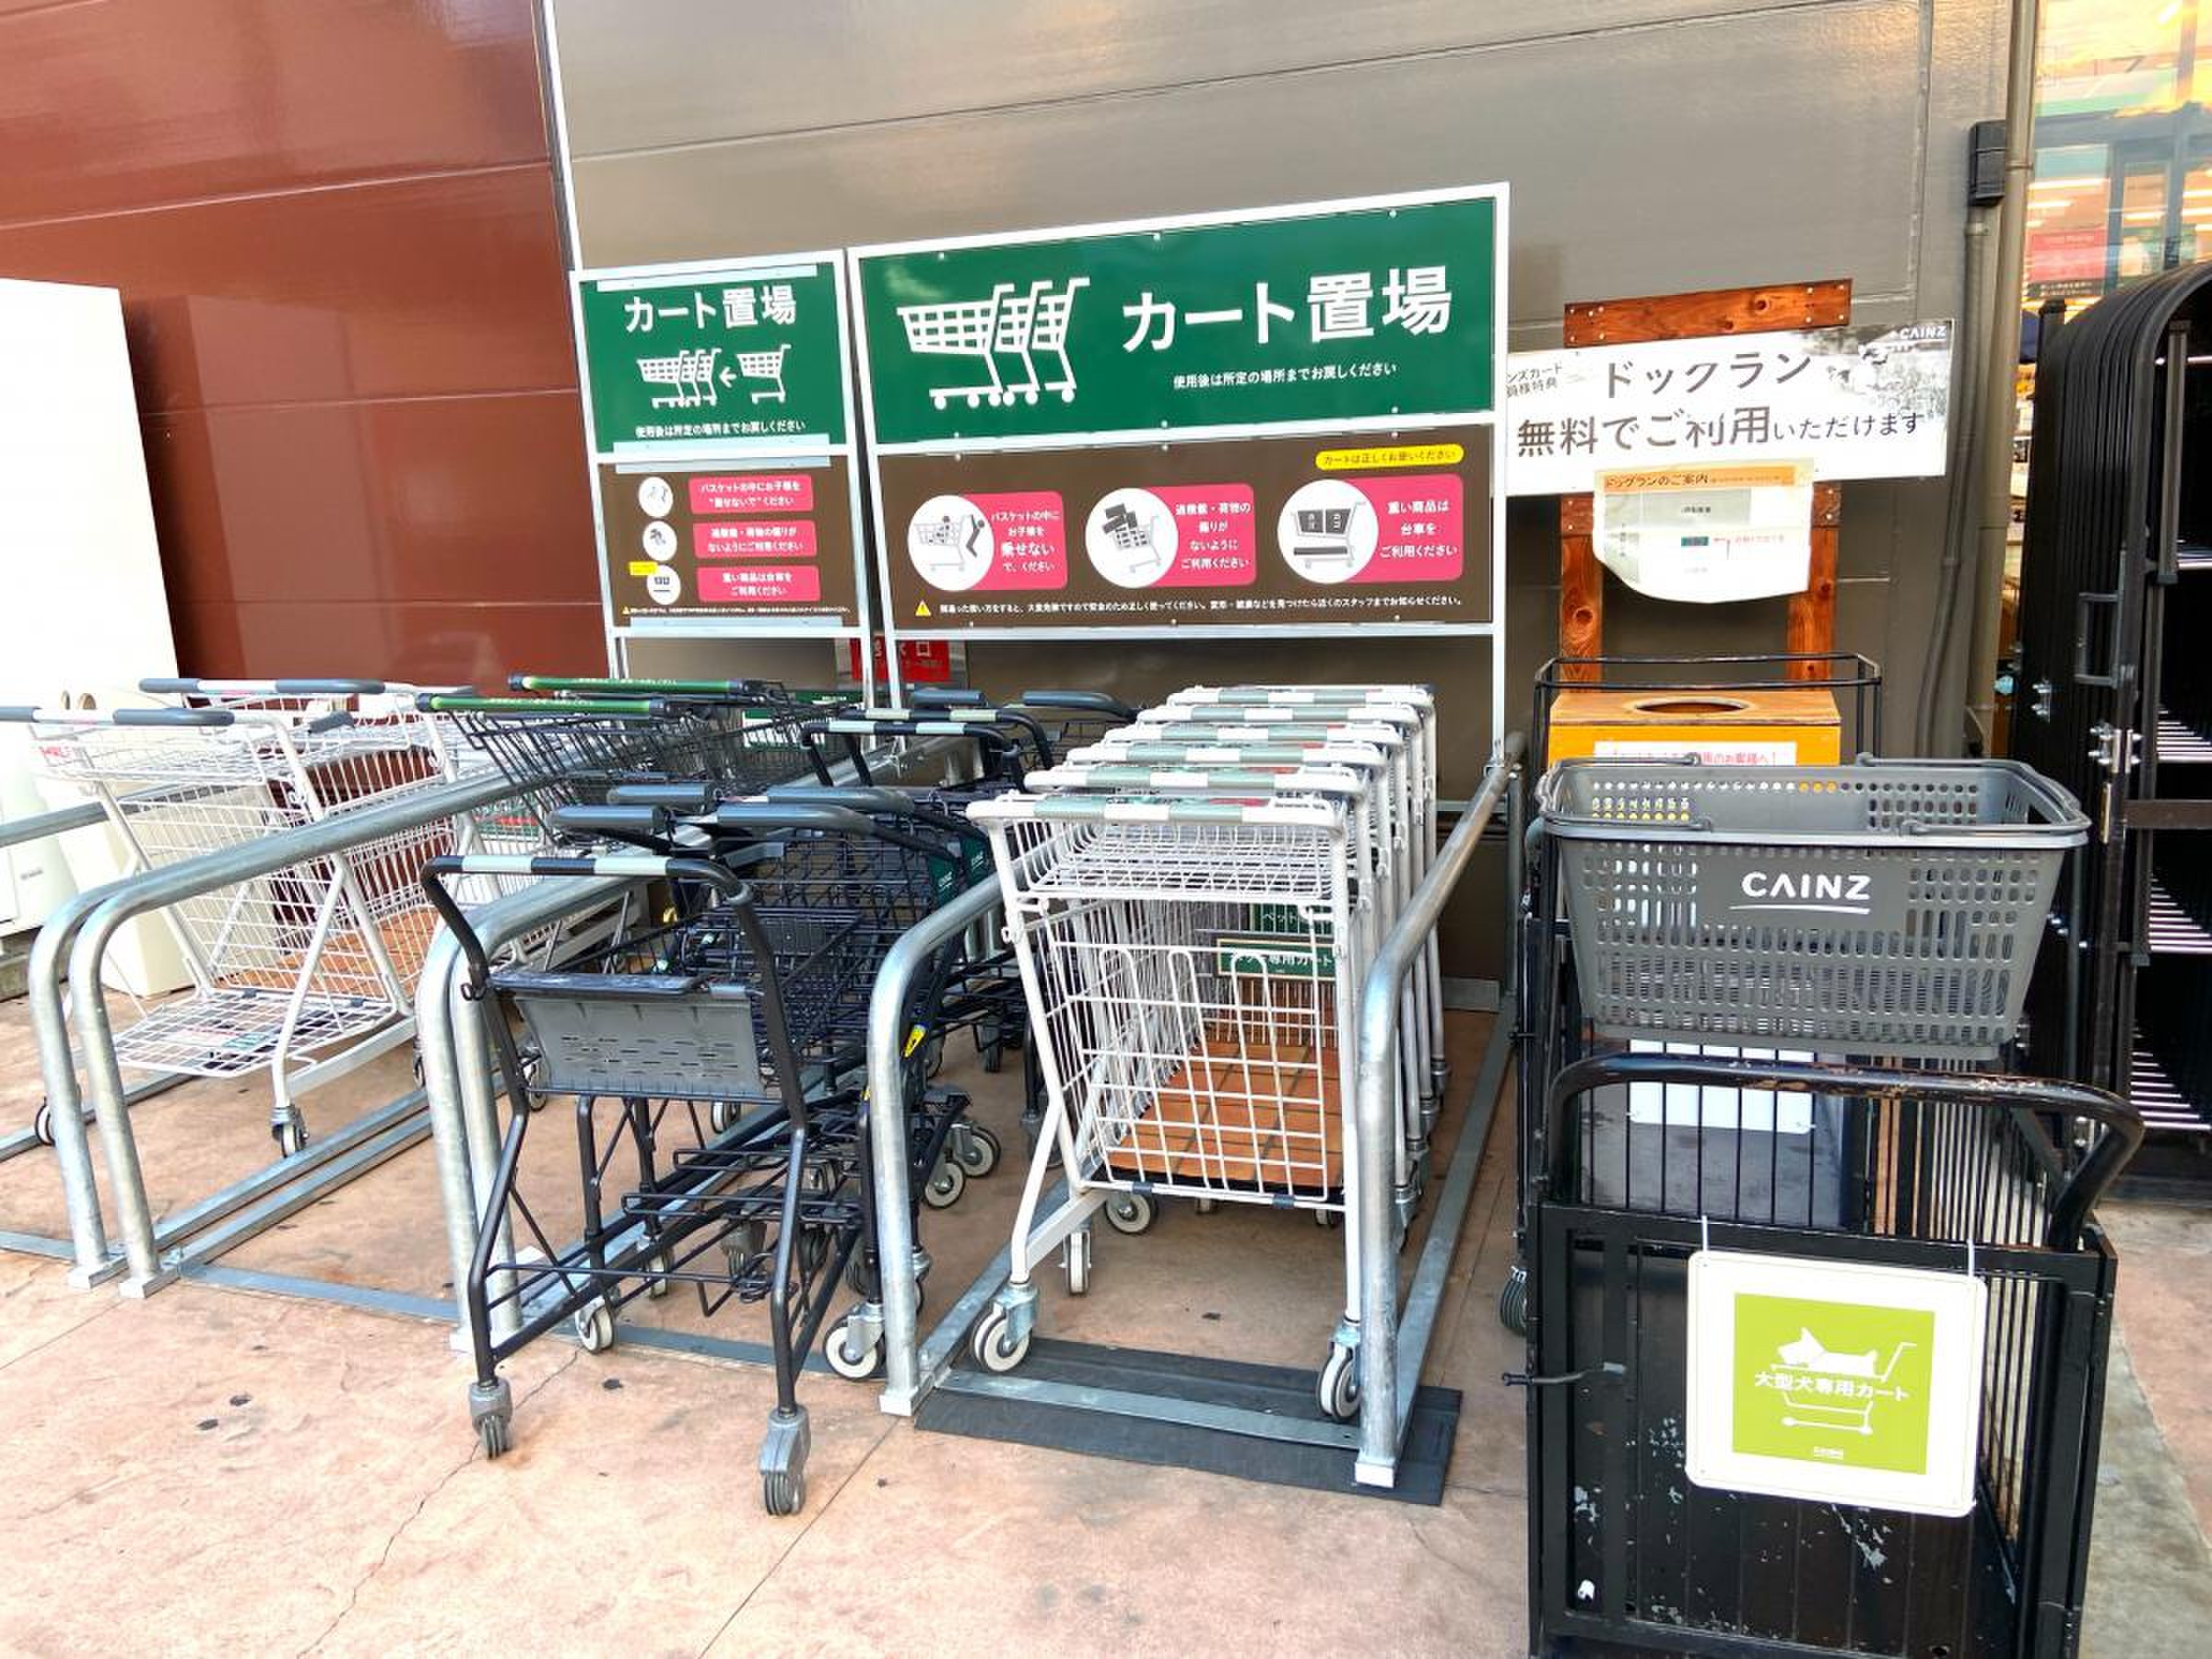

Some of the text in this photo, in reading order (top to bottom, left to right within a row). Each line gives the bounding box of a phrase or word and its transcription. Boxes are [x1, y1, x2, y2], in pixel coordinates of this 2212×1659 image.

[624, 285, 797, 333] カート置場
[1123, 265, 1453, 353] カート置場
[1900, 325, 1947, 339] CAINZ
[1173, 362, 1397, 390] 使用後は所定の場所までお戻しください
[1607, 352, 1811, 398] ドックラン
[1517, 405, 1924, 457] 無料でご利用いただけます
[1387, 500, 1450, 514] 重い商品は
[1400, 523, 1436, 536] 台車を
[1380, 545, 1458, 559] ご利用ください
[1741, 872, 1871, 900] CAINZ
[1755, 1371, 1910, 1402] 大型犬専用カート
